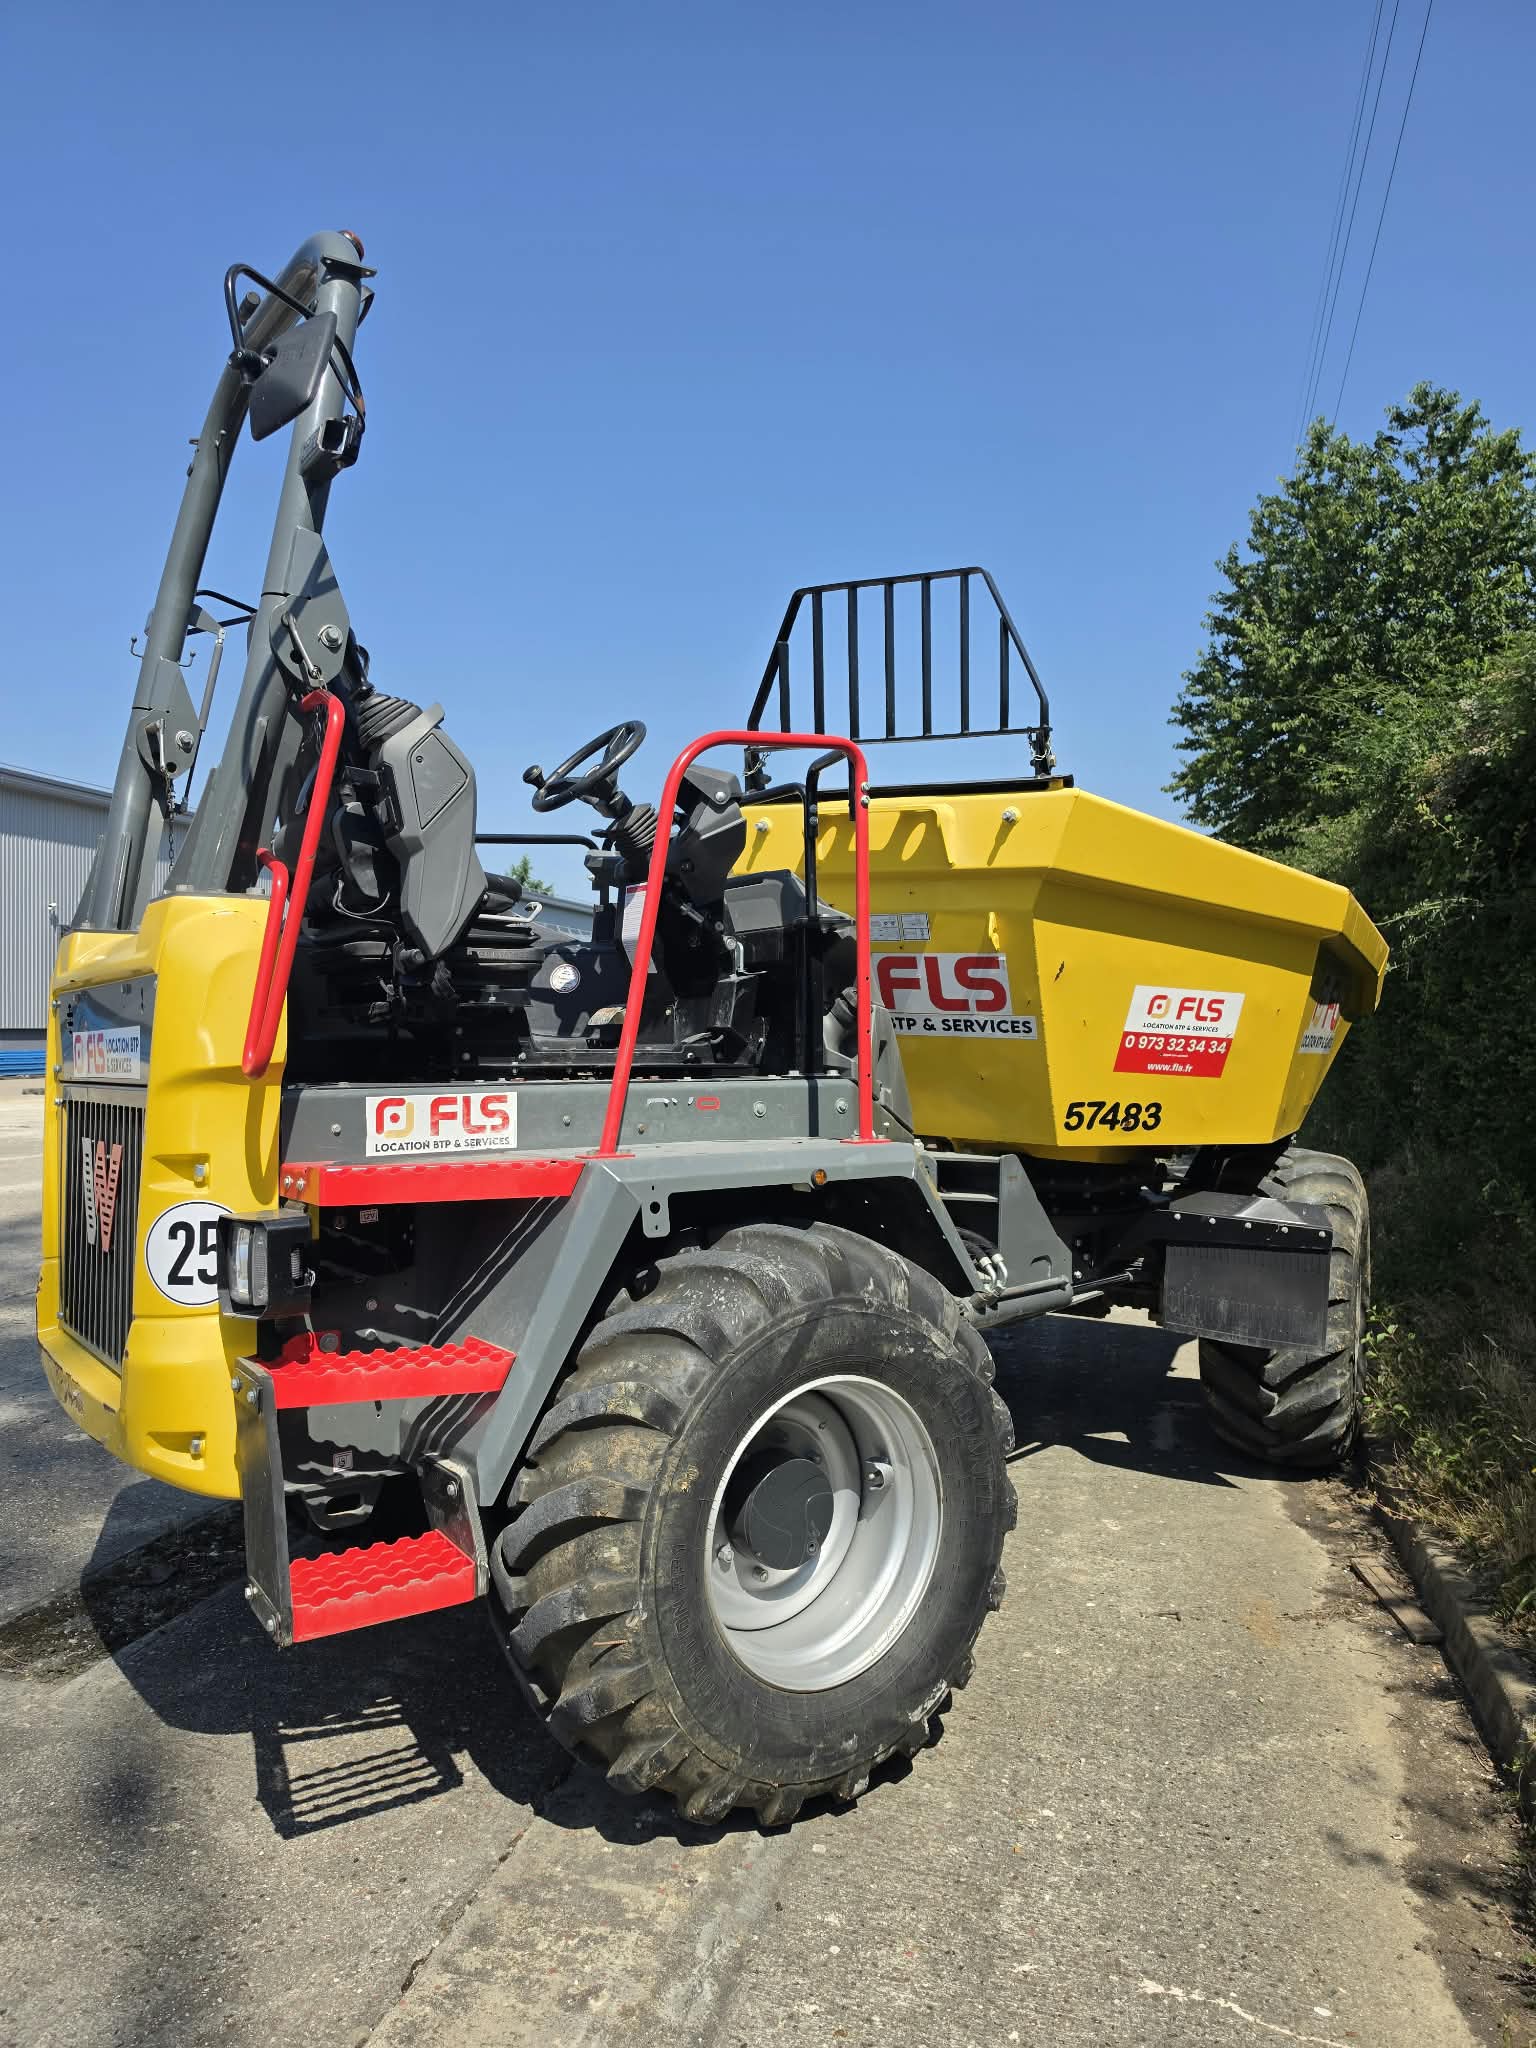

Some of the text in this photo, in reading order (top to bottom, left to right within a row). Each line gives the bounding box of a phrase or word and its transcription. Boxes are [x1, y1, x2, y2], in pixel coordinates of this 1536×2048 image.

[877, 956, 1008, 1012] FLS
[1176, 997, 1226, 1023] FLS
[923, 1018, 937, 1032] &
[942, 1018, 1033, 1034] SERVICES
[1143, 1022, 1174, 1030] LOCATION
[1192, 1025, 1219, 1033] SERVICES
[87, 1033, 105, 1074] FLS
[106, 1036, 139, 1054] LOCATION BTP
[1125, 1035, 1227, 1055] 0 973 32 34 34
[1147, 1062, 1193, 1073] www.fls.fr
[430, 1095, 510, 1136] FLS
[1064, 1101, 1163, 1132] 57483
[375, 1136, 510, 1153] LOCATION BTP & SERVICES
[167, 1220, 219, 1287] 25
